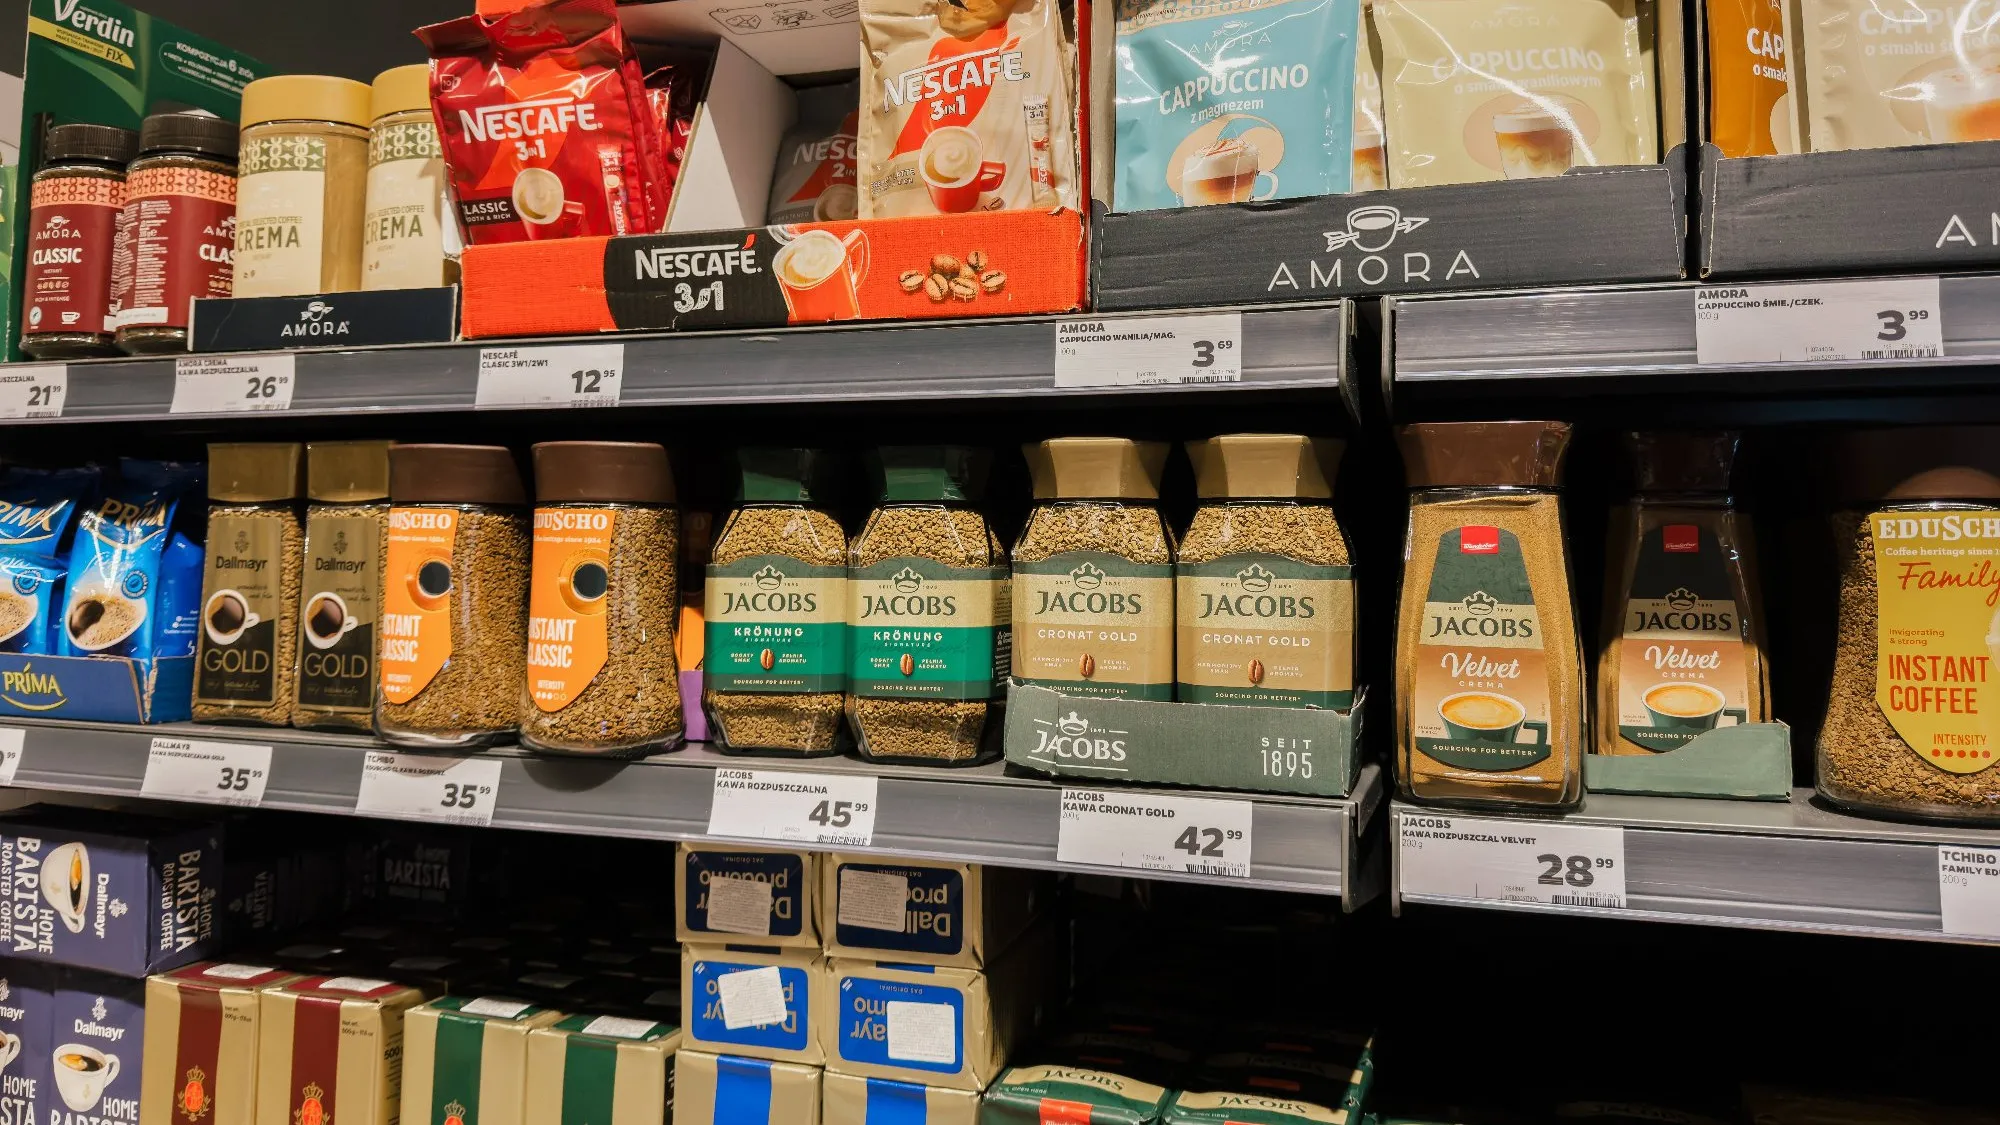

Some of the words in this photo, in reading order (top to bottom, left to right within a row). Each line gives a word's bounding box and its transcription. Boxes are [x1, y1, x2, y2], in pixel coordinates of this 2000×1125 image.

[54, 0, 134, 48] Verdin
[1189, 32, 1272, 54] AMORA
[1880, 40, 1934, 55] smaku
[106, 48, 124, 63] FIX
[1432, 47, 1605, 80] CAPPUCCINO
[1753, 63, 1760, 75] o
[1160, 64, 1309, 115] CAPPUCCINO
[1198, 98, 1264, 122] magnezem
[36, 229, 81, 240] AMORA
[238, 226, 300, 252] CREMA
[366, 215, 423, 245] CREMA
[32, 247, 82, 265] CLASSIC
[1267, 249, 1480, 291] AMORA
[1698, 288, 1749, 300] AMORA
[1698, 300, 1760, 310] CAPPUCCINO
[1762, 298, 1824, 308] ŚMIE./CZEK.
[281, 321, 347, 337] AMORA
[1059, 323, 1105, 333] AMORA
[1876, 310, 1907, 341] 3
[1908, 310, 1928, 320] 99
[1059, 334, 1111, 343] CAPPUCCINO
[1113, 332, 1176, 341] WANILIA/MAG.
[482, 350, 518, 360] NESCAFÉ
[1191, 340, 1215, 367] 3
[1218, 340, 1233, 349] 69
[246, 377, 276, 399] 26
[571, 369, 601, 393] 12
[27, 386, 51, 406] 21
[389, 511, 451, 530] DUSCHO
[1885, 547, 1918, 556] Coffee
[1920, 547, 1965, 558] heritage
[1967, 548, 1993, 556] since
[215, 556, 268, 572] Dallmayr
[315, 557, 366, 574] Dallmayr
[1897, 559, 2000, 607] Family
[722, 592, 817, 615] JACOBS
[861, 595, 956, 618] JACOBS
[1034, 590, 1142, 615] JACOBS
[1199, 593, 1315, 619] JACOBS
[734, 626, 803, 637] KRÖNUNG
[1430, 616, 1533, 638] JACOBS
[1633, 611, 1731, 632] JACOBS
[873, 629, 943, 641] KRÖNUNG
[1038, 629, 1093, 641] CRONAT
[1099, 631, 1137, 642] GOLD
[1202, 633, 1263, 645] CRONAT
[1268, 635, 1311, 647] GOLD
[1889, 628, 1945, 638] Invigorating
[1897, 637, 1928, 646] strong
[204, 649, 269, 673] GOLD
[304, 653, 368, 678] GOLD
[1440, 652, 1521, 679] Velvet
[1644, 645, 1720, 670] Velvet
[1889, 654, 1989, 682] INSTANT
[1459, 680, 1504, 689] CREMA
[1889, 685, 1978, 714] COFFEE
[153, 741, 190, 750] DALLMAYR
[1031, 729, 1127, 762] JACOBS
[1261, 737, 1312, 750] SEIT
[1432, 744, 1477, 753] SOURCING
[1480, 747, 1497, 755] FOR
[1933, 733, 1987, 746] INTENSITY
[367, 755, 395, 764] TCHIBO
[1261, 749, 1313, 778] 1895
[217, 767, 250, 791] 35
[252, 770, 262, 778] 99
[717, 771, 753, 780] JACOBS
[441, 783, 477, 808] 35
[480, 786, 490, 794] 99
[716, 780, 745, 789] KAWA
[747, 782, 828, 794] ROZPUSZCZALNA
[1063, 791, 1104, 802] JACOBS
[809, 800, 852, 827] 45
[855, 803, 868, 812] 99
[1063, 802, 1096, 812] KAWA
[1099, 804, 1143, 816] CRONAT
[1145, 808, 1175, 818] GOLD
[1402, 817, 1451, 829] JACOBS
[1174, 826, 1224, 858] 42
[1226, 830, 1243, 840] 99
[1402, 830, 1431, 839] KAWA
[1433, 832, 1499, 843] ROZPUSZCZAL
[1501, 836, 1536, 845] VELVET
[1942, 851, 1997, 864] TCHIBO
[1, 842, 14, 896] ROASTED
[1537, 853, 1594, 887] 28
[1596, 858, 1613, 868] 99
[1942, 865, 1982, 875] FAMILY
[161, 863, 176, 910] ROASTED
[1943, 875, 1959, 884] 200
[1961, 877, 1967, 887] g
[14, 836, 42, 952] BARISTA
[176, 849, 202, 953] BARISTA
[94, 873, 110, 939] Dallmayr
[0, 900, 12, 943] COFFEE
[39, 909, 55, 954] HOME
[161, 912, 174, 950] COFFEE
[200, 903, 213, 941] HOME
[74, 1018, 125, 1041] Dallmayr
[3, 1075, 36, 1099] HOME
[1044, 1070, 1125, 1090] JACOBS
[103, 1096, 138, 1121] HOME
[1218, 1096, 1307, 1113] JACOBS
